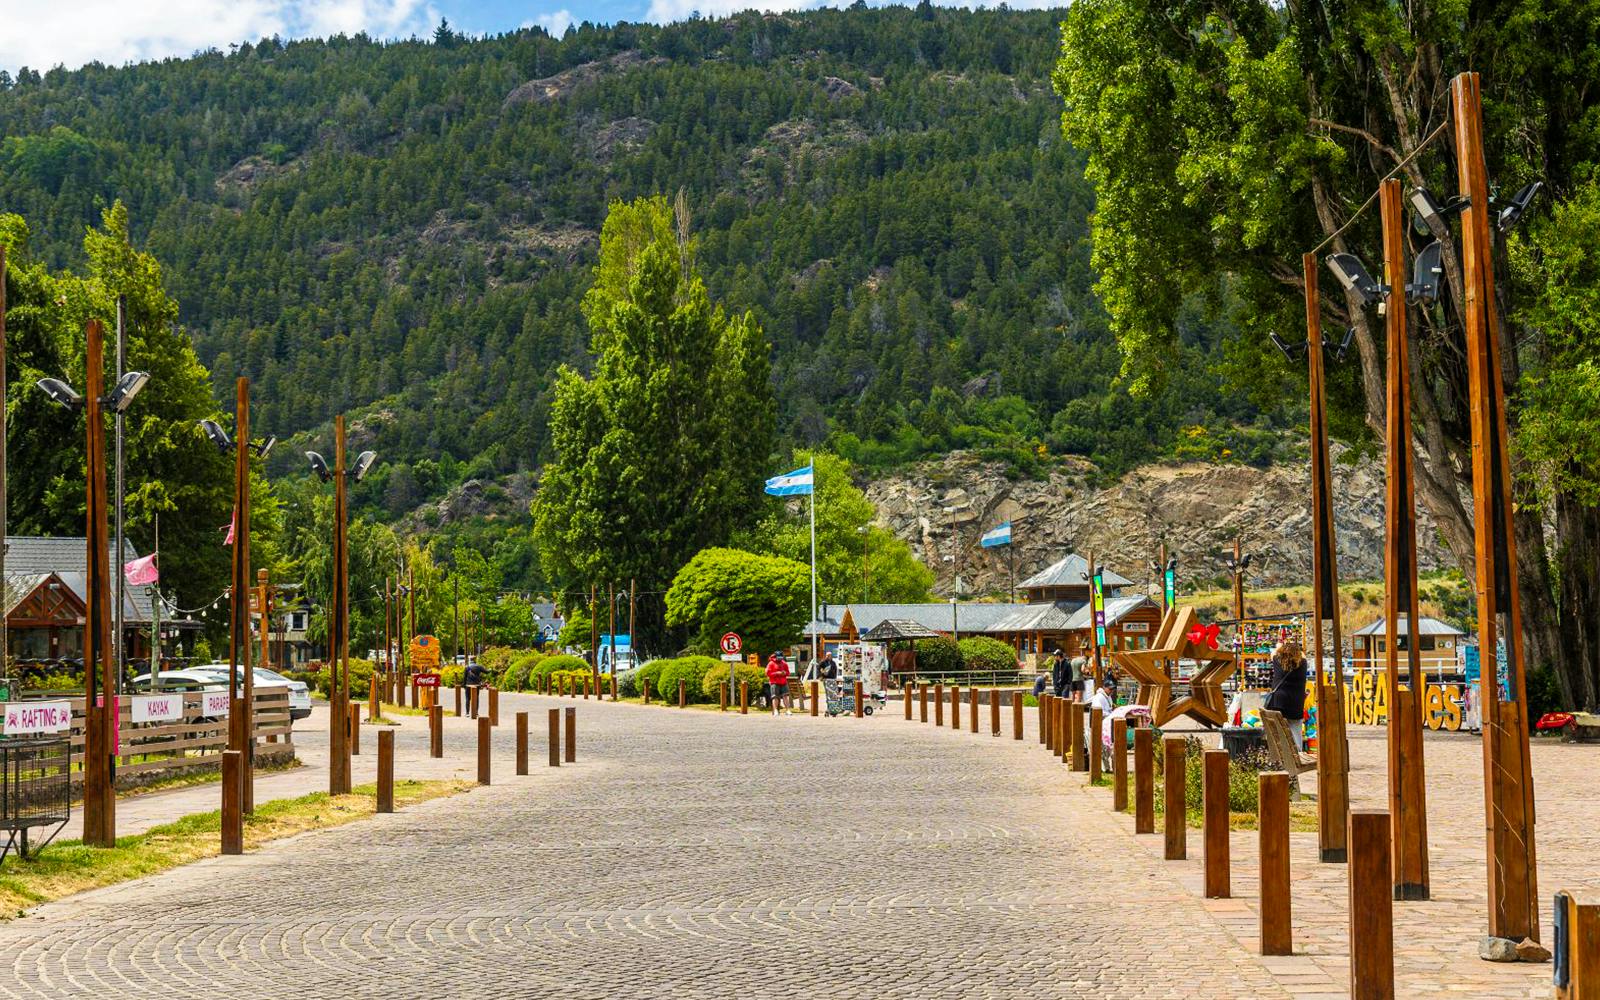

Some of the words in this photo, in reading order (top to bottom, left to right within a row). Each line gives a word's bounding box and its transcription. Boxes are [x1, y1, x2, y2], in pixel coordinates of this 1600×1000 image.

[1353, 668, 1372, 699] de
[148, 699, 170, 716] KAYAK
[209, 696, 230, 711] PARAPE
[1350, 692, 1373, 725] los
[1372, 673, 1462, 731] Aes
[22, 708, 57, 728] RAFTING
